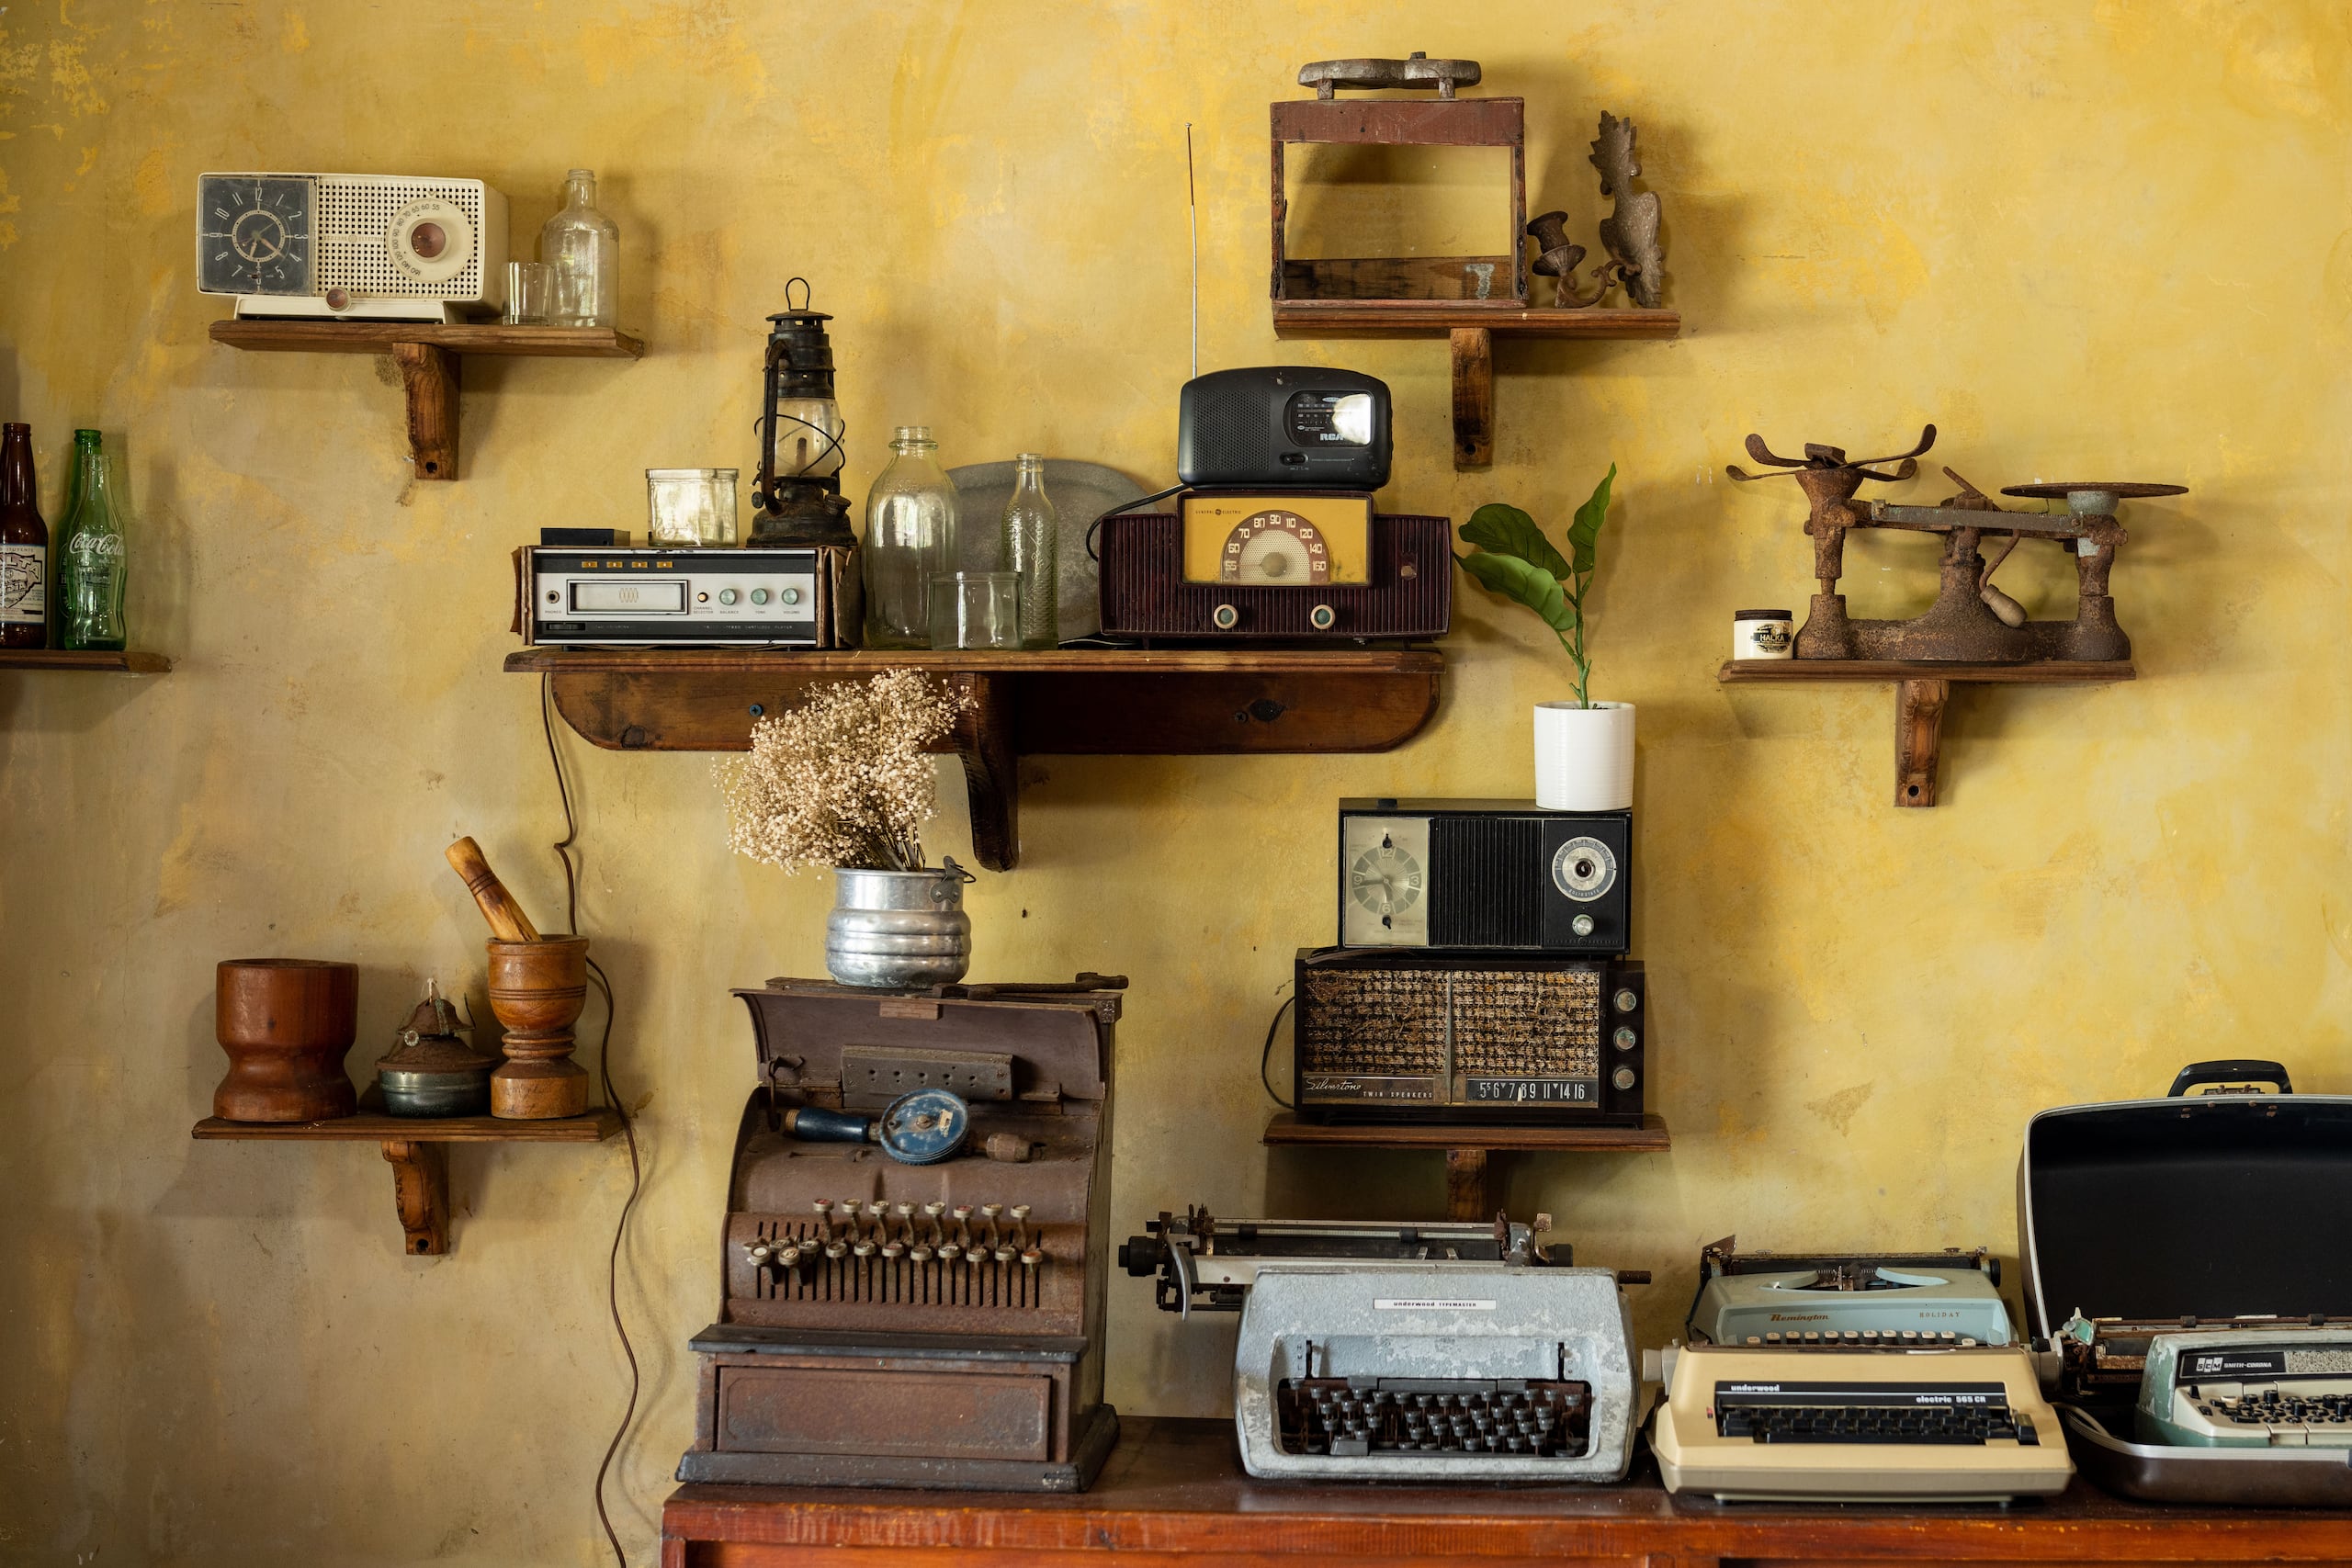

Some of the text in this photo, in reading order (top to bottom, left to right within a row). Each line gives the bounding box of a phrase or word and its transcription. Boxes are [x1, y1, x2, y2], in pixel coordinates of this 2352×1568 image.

[254, 186, 263, 202] 12
[1253, 517, 1265, 528] 80
[1270, 514, 1281, 525] 90
[1286, 517, 1296, 528] 110
[1238, 528, 1250, 538] 70
[1300, 528, 1313, 539] 120
[1228, 543, 1240, 553] 60
[1309, 544, 1322, 554] 140
[1225, 560, 1237, 571] 55
[1313, 560, 1326, 571] 160
[1381, 848, 1393, 858] 12
[1353, 875, 1363, 886] 9
[1411, 875, 1419, 886] 3
[1382, 904, 1391, 913] 6
[1493, 1083, 1499, 1098] 6
[1509, 1083, 1515, 1099] 7
[1529, 1083, 1536, 1099] 9
[1560, 1083, 1570, 1100] 14
[1574, 1084, 1585, 1100] 16
[1770, 1314, 1829, 1323] Remington
[2197, 1361, 2222, 1371] SCM
[1916, 1395, 1952, 1404] electric
[1973, 1395, 1986, 1404] CR
